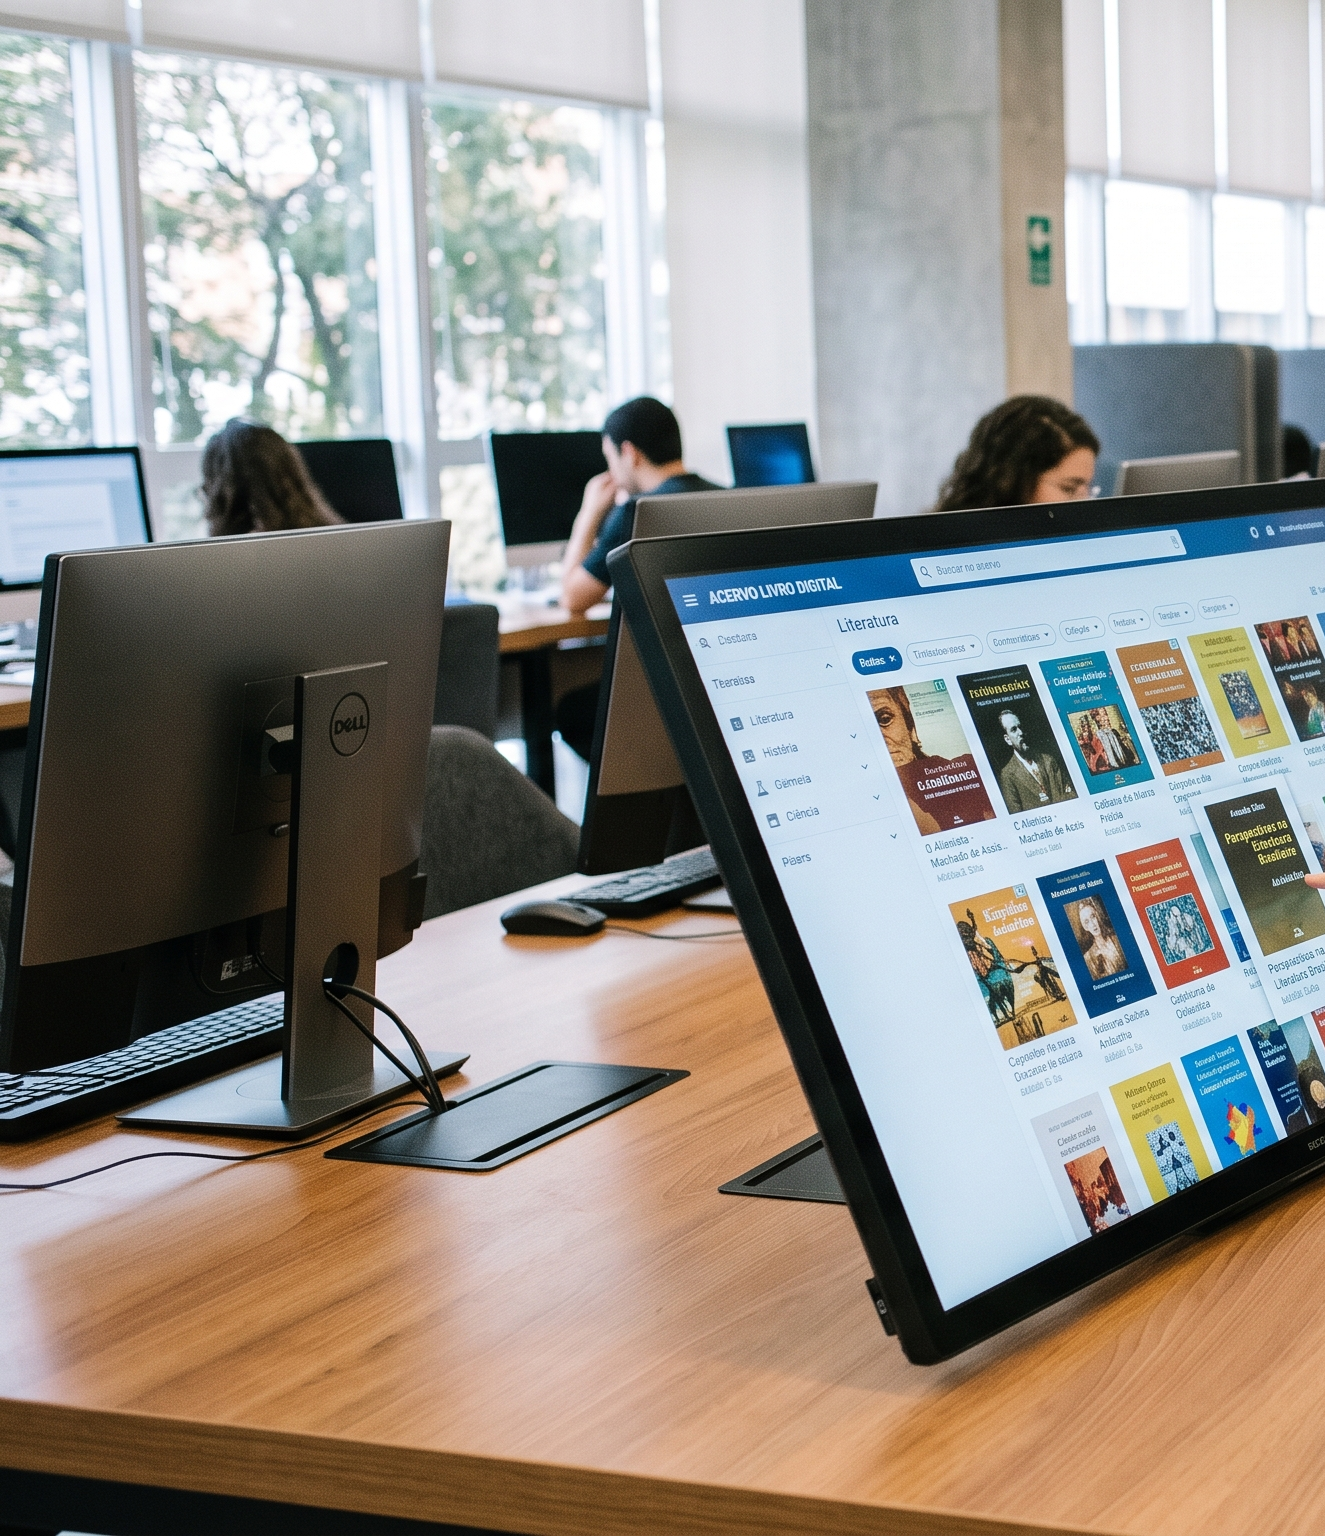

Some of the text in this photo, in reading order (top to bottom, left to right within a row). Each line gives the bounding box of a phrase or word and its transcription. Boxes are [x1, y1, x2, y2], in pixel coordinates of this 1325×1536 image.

[709, 576, 843, 605] ACERVO LIVRO DIGITAL
[836, 614, 900, 633] Literatura
[334, 714, 366, 735] DELL
[749, 711, 794, 726] Literatura
[786, 807, 820, 822] Ciência
